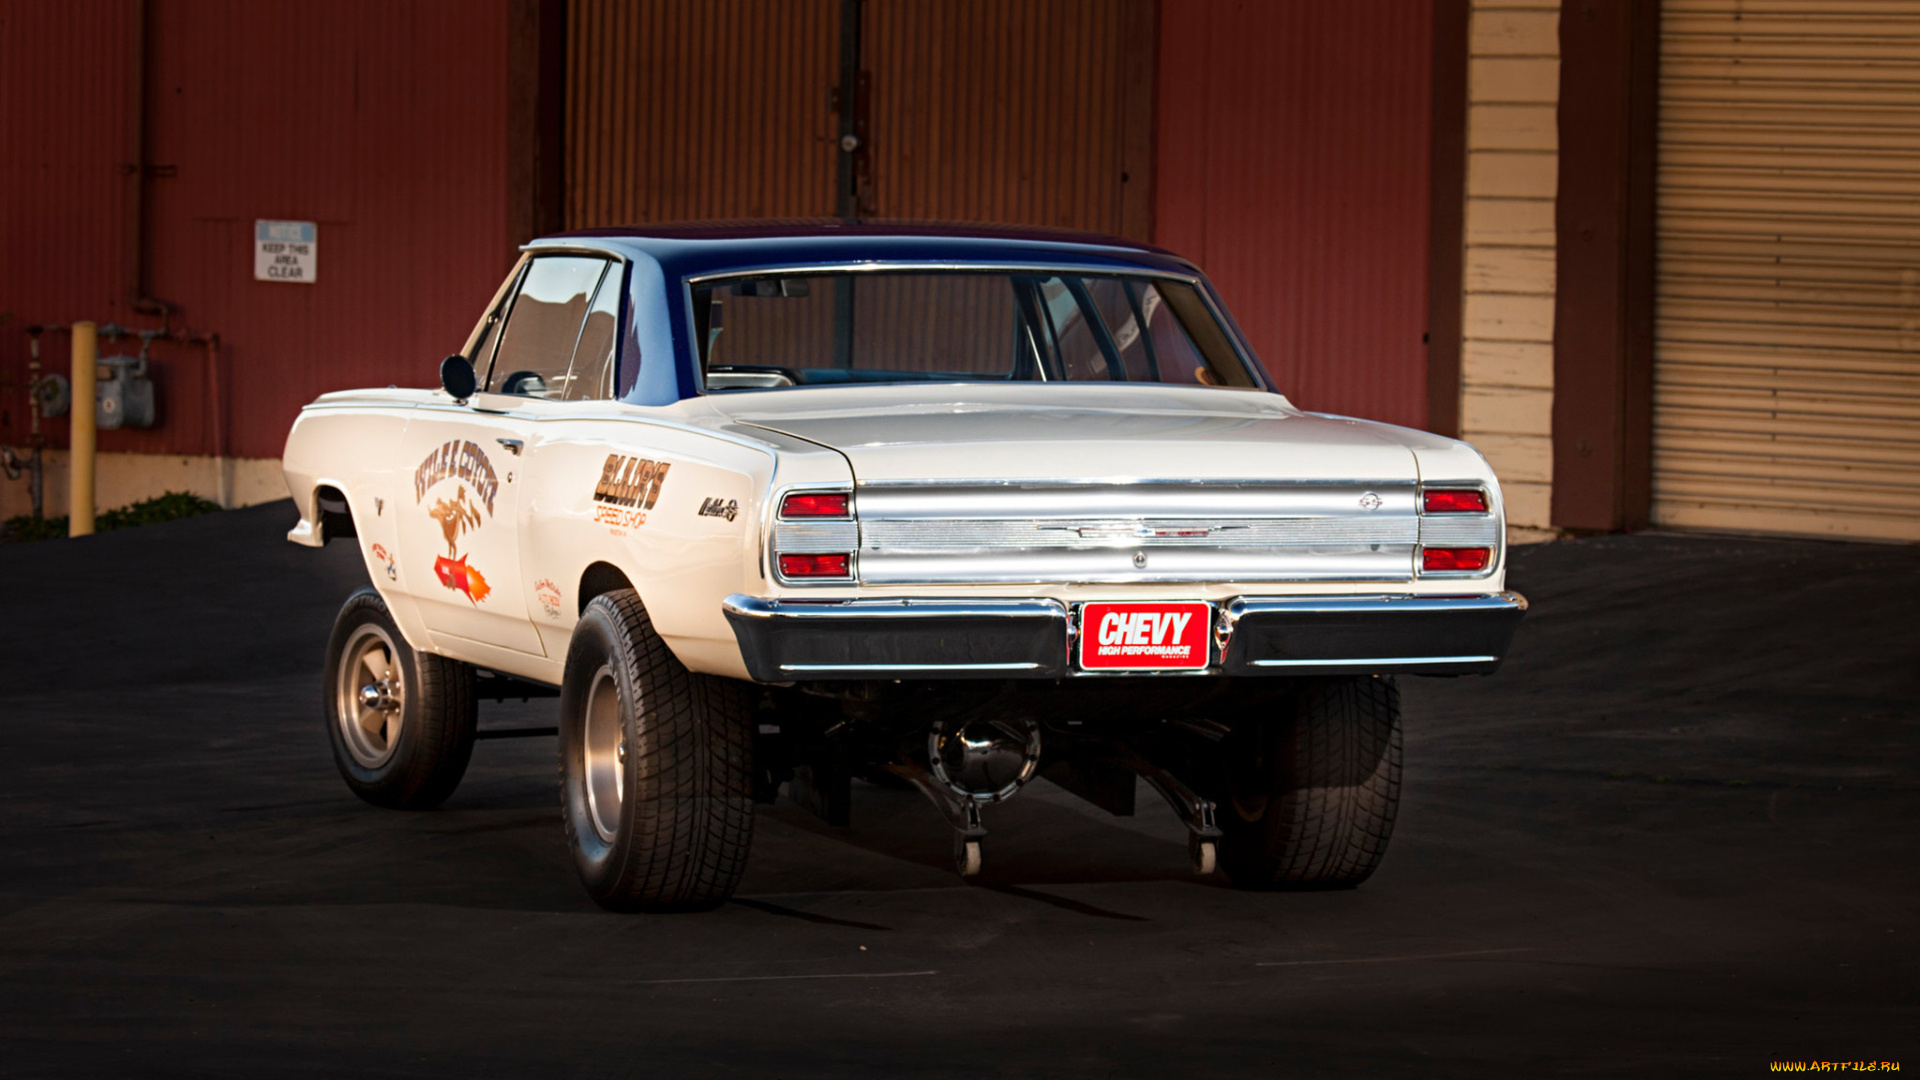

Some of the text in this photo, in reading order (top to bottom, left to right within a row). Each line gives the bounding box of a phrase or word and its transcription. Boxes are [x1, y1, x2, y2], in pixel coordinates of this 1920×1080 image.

[262, 243, 309, 256] KEEP THIS
[275, 255, 298, 265] AREA
[267, 266, 303, 278] CLEAR
[594, 505, 647, 529] SPEED SHOP
[1098, 611, 1193, 646] CHEVY
[1098, 646, 1191, 655] HIGH PERFORMANCE
